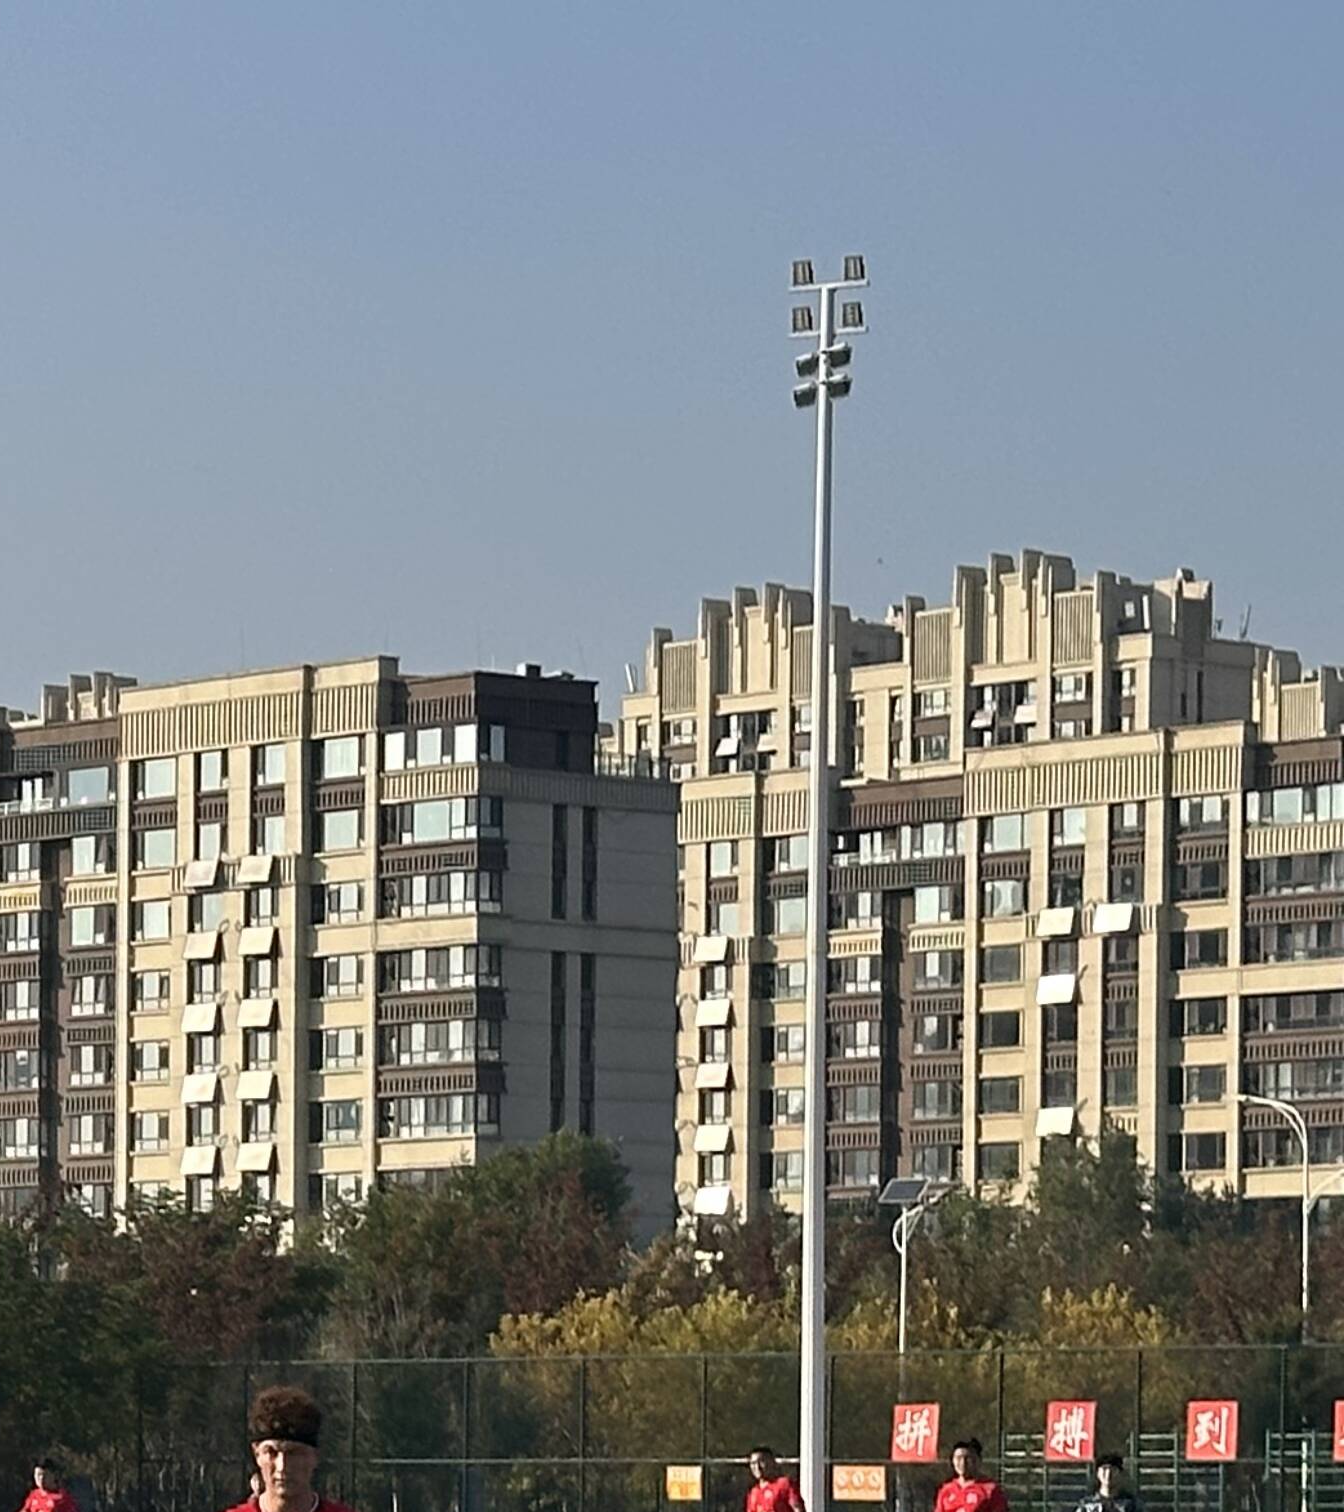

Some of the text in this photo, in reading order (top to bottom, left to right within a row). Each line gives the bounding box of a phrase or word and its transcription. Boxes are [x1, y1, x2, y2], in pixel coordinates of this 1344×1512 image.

[894, 1406, 1229, 1458] 拼 搏 到
